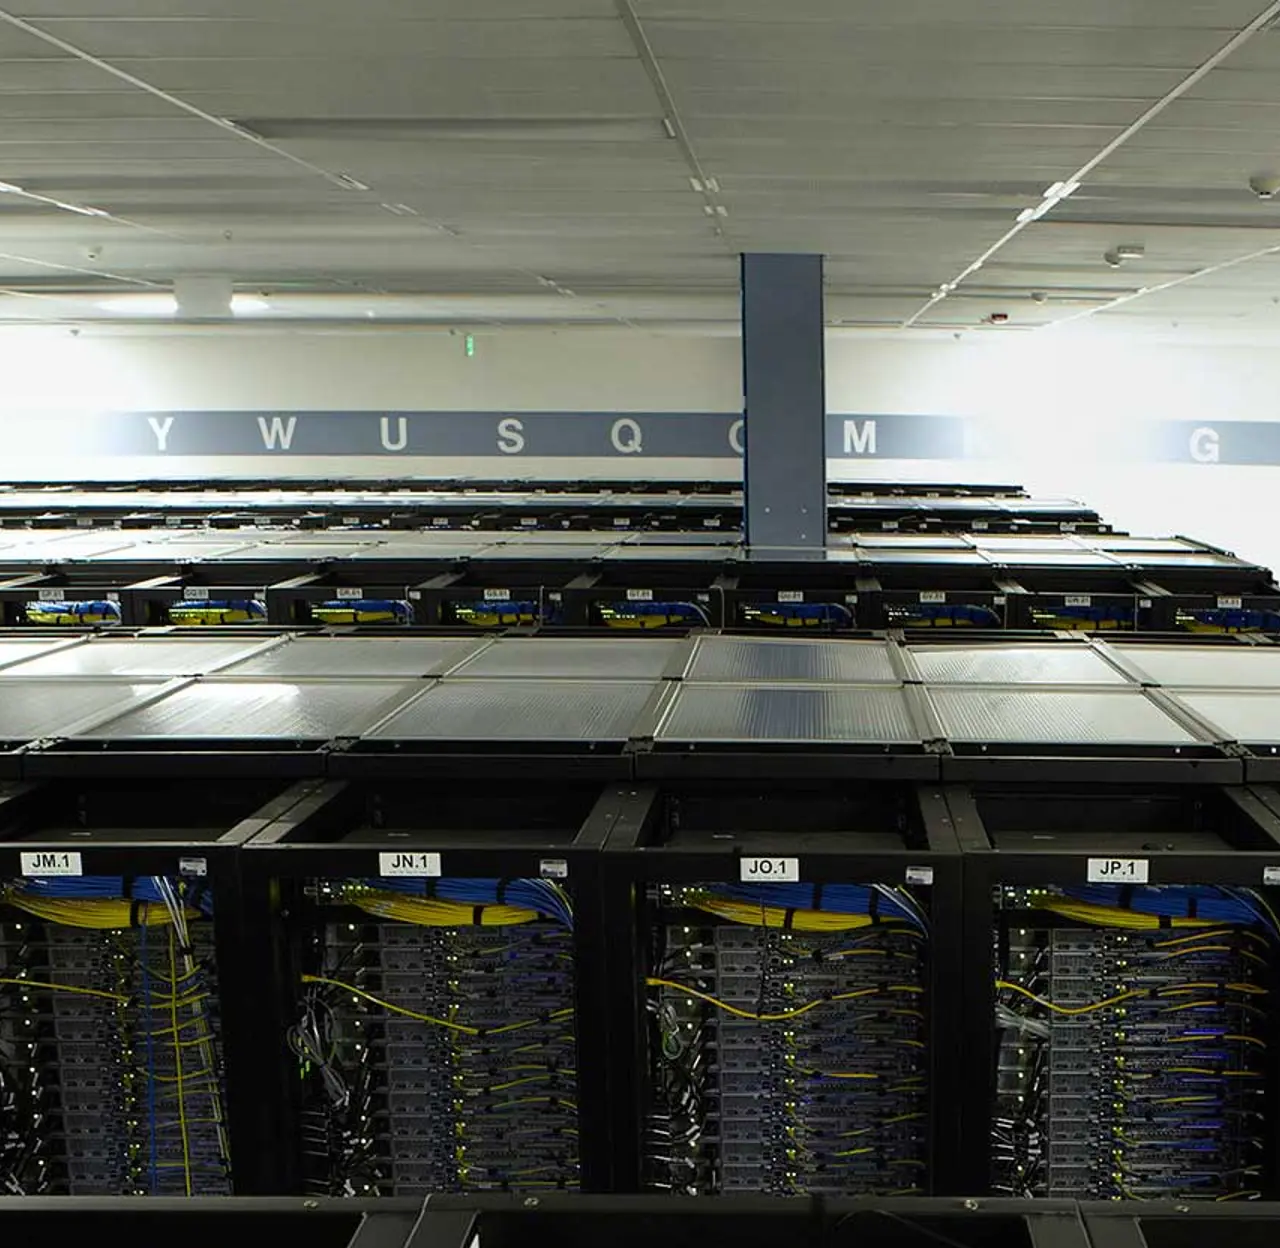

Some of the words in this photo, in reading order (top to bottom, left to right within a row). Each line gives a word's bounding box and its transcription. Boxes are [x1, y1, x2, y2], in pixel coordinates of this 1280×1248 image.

[147, 417, 175, 451] Y
[256, 416, 298, 450] W
[379, 416, 408, 451] U
[497, 417, 525, 454] S
[610, 417, 643, 454] Q
[843, 420, 877, 454] M
[1188, 426, 1220, 463] G
[32, 854, 70, 868] JM.1
[391, 854, 428, 868] JN.1
[748, 860, 786, 874] JO.1
[1100, 861, 1135, 875] JP.1
